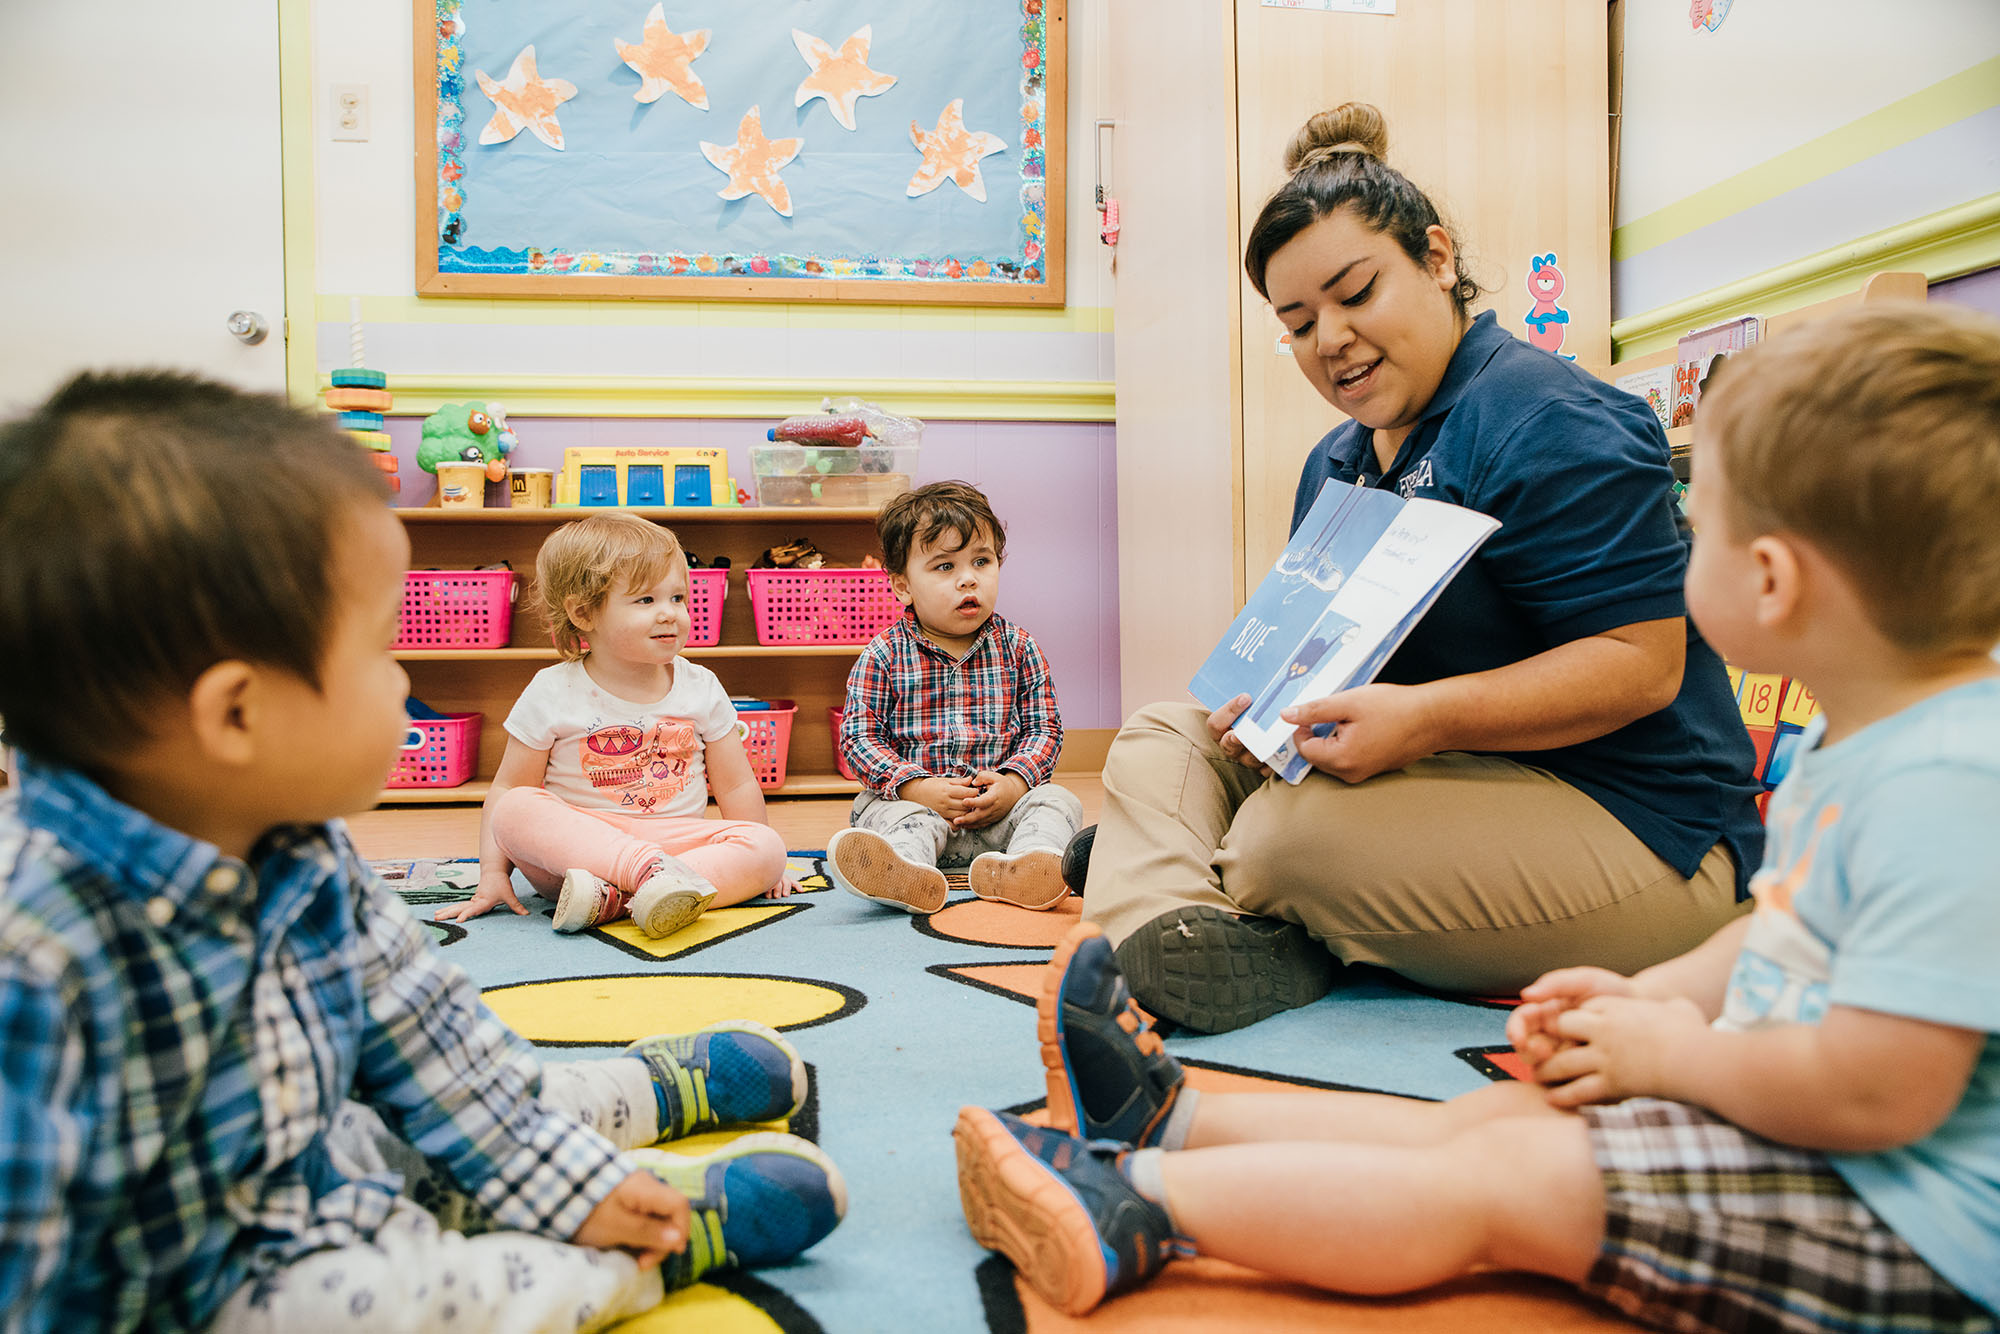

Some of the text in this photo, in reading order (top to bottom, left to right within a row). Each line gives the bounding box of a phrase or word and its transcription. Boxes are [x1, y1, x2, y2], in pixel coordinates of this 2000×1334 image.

[1676, 367, 1700, 383] Carry
[1679, 382, 1694, 397] Me
[637, 449, 670, 457] Service
[1230, 616, 1278, 662] BLUE
[1748, 682, 1772, 714] 18
